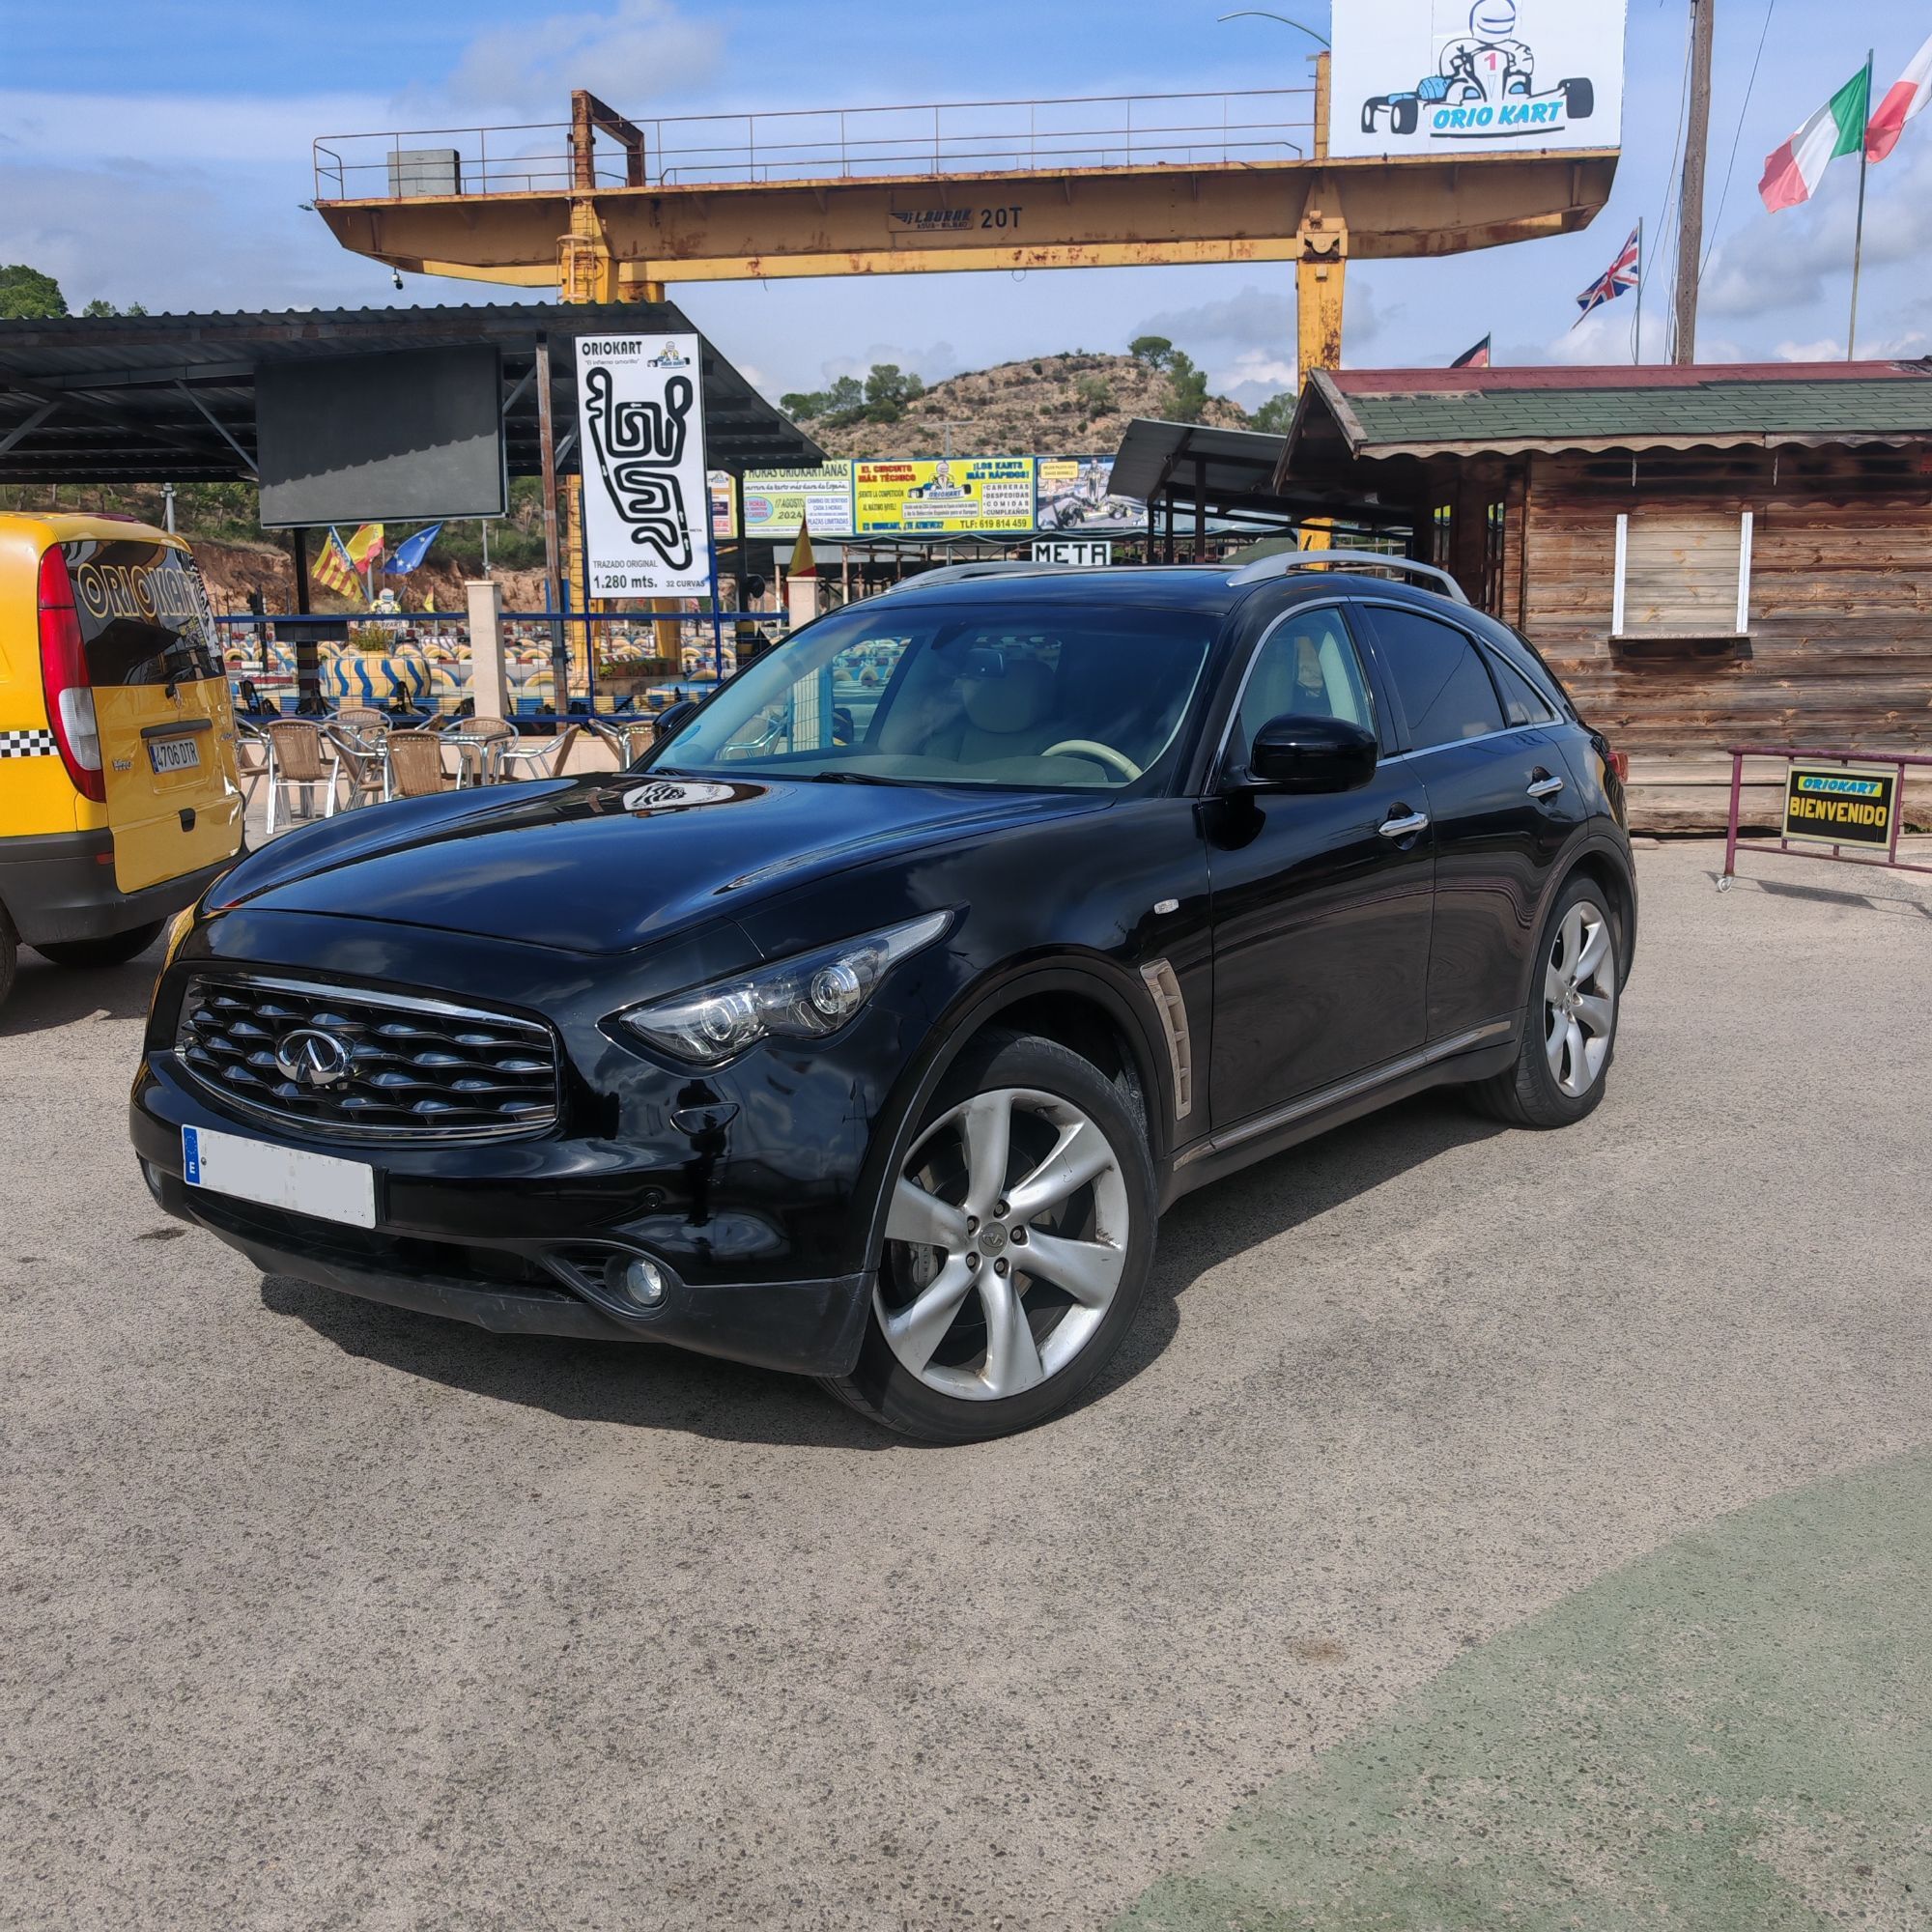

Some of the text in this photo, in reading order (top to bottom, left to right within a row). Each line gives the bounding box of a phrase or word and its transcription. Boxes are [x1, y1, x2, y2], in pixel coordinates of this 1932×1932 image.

[1484, 52, 1496, 71] 1
[1433, 101, 1564, 129] ORIO KART
[980, 207, 1023, 229] 20T
[582, 341, 642, 356] ORIOKART
[873, 465, 912, 473] CIRCUITO
[995, 461, 1023, 470] KARTS
[777, 511, 803, 520] 2024
[960, 519, 1027, 529] TLF: 619 814 459
[1036, 543, 1107, 565] META
[593, 558, 659, 569] TRAZADO ORIGINAL
[593, 575, 659, 589] 1.280 mts.
[666, 580, 676, 588] 32
[156, 741, 198, 768] 4706 DTR
[1803, 778, 1879, 794] ORIOKART
[1789, 796, 1888, 827] BIENVENIDO
[188, 1161, 196, 1175] E
